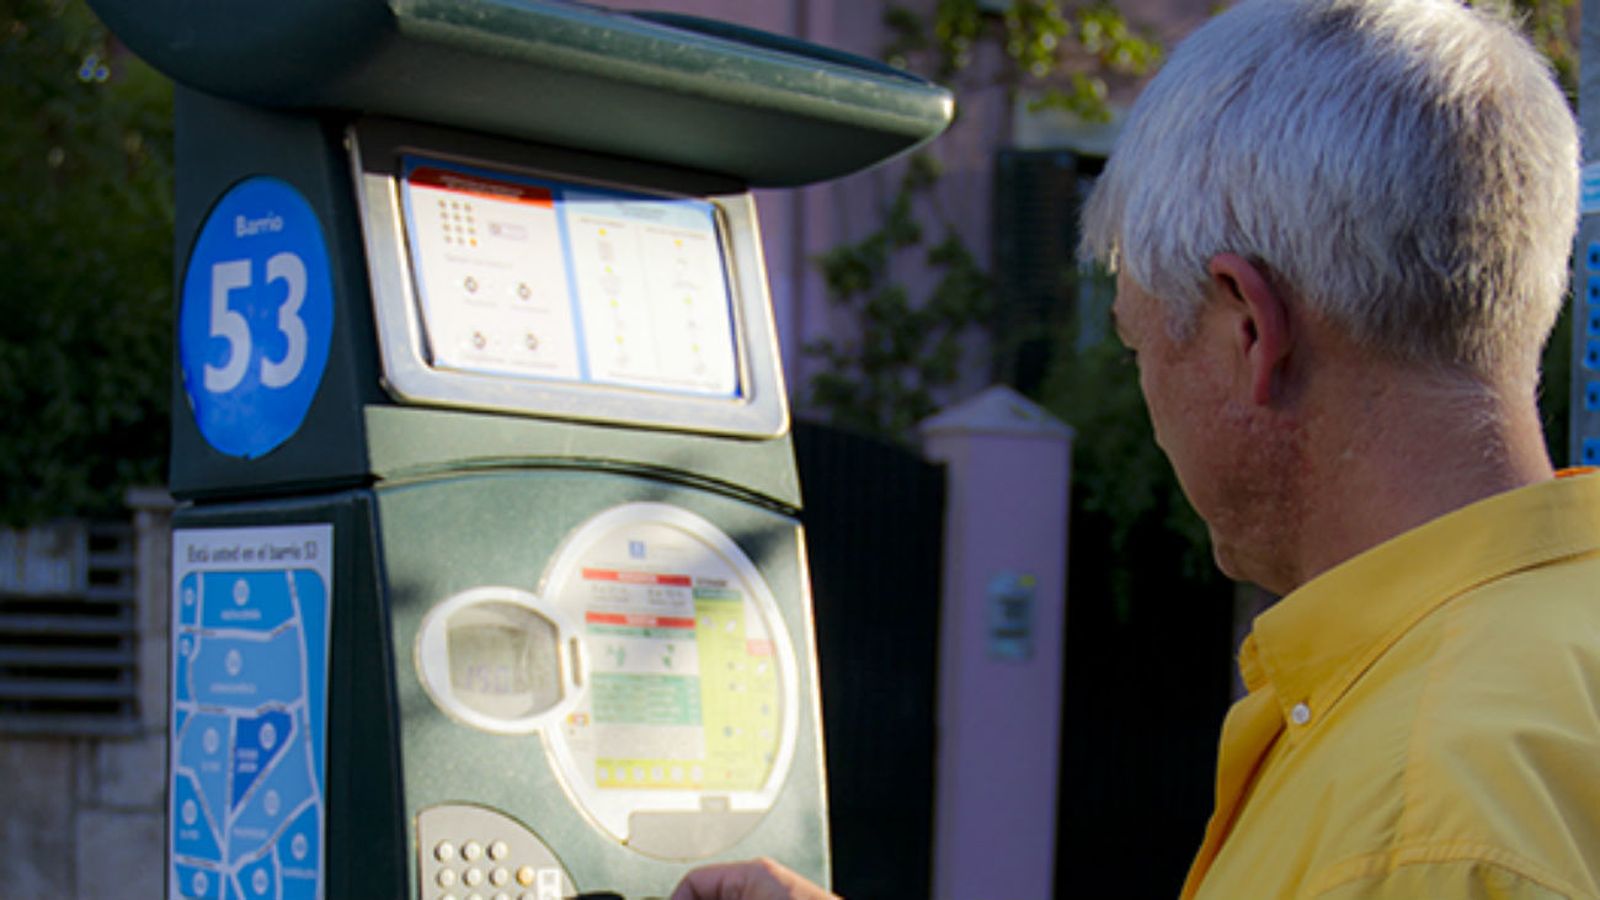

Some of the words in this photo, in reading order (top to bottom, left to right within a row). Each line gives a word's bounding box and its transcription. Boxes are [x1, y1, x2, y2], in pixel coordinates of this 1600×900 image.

[235, 212, 284, 238] Barrio
[203, 252, 308, 393] 53
[187, 543, 209, 562] Está
[212, 544, 240, 562] usted
[242, 548, 255, 561] en
[270, 542, 302, 560] barrio
